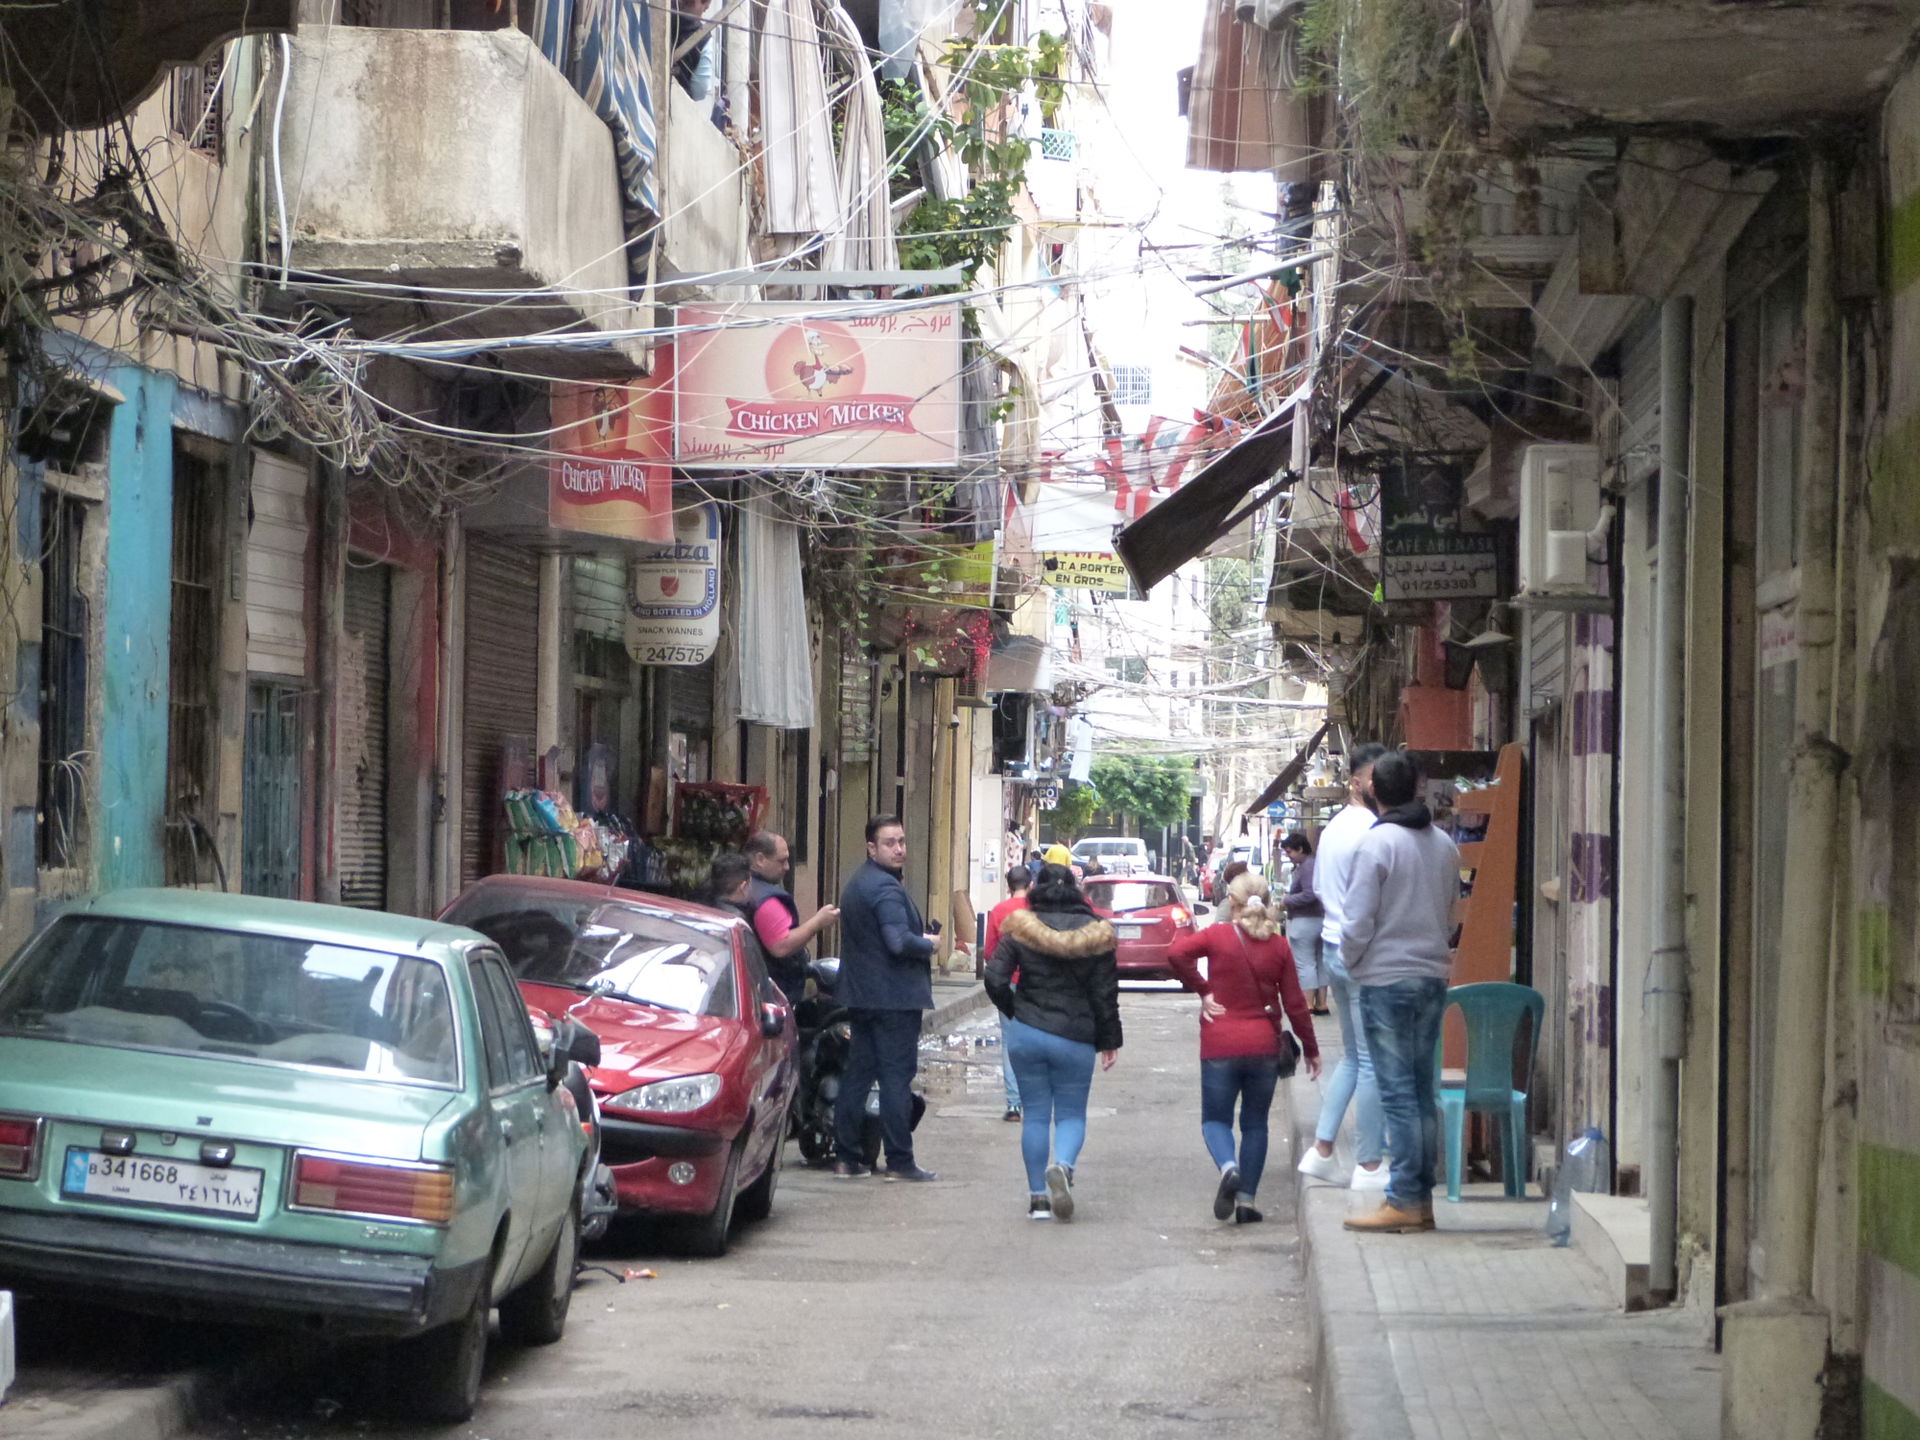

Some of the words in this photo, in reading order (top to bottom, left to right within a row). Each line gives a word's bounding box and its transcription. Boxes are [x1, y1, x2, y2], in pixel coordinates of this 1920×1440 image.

[1069, 562, 1076, 571] A
[1080, 563, 1124, 574] PORTER
[1056, 574, 1070, 583] EN
[1074, 575, 1104, 586] GROS
[652, 608, 692, 616] BOTTLED
[693, 608, 703, 616] IN
[703, 570, 716, 612] HOLLAND
[638, 626, 665, 634] SNACK
[667, 626, 703, 636] WANNES
[646, 647, 704, 662] 247575
[101, 1158, 178, 1184] 341668
